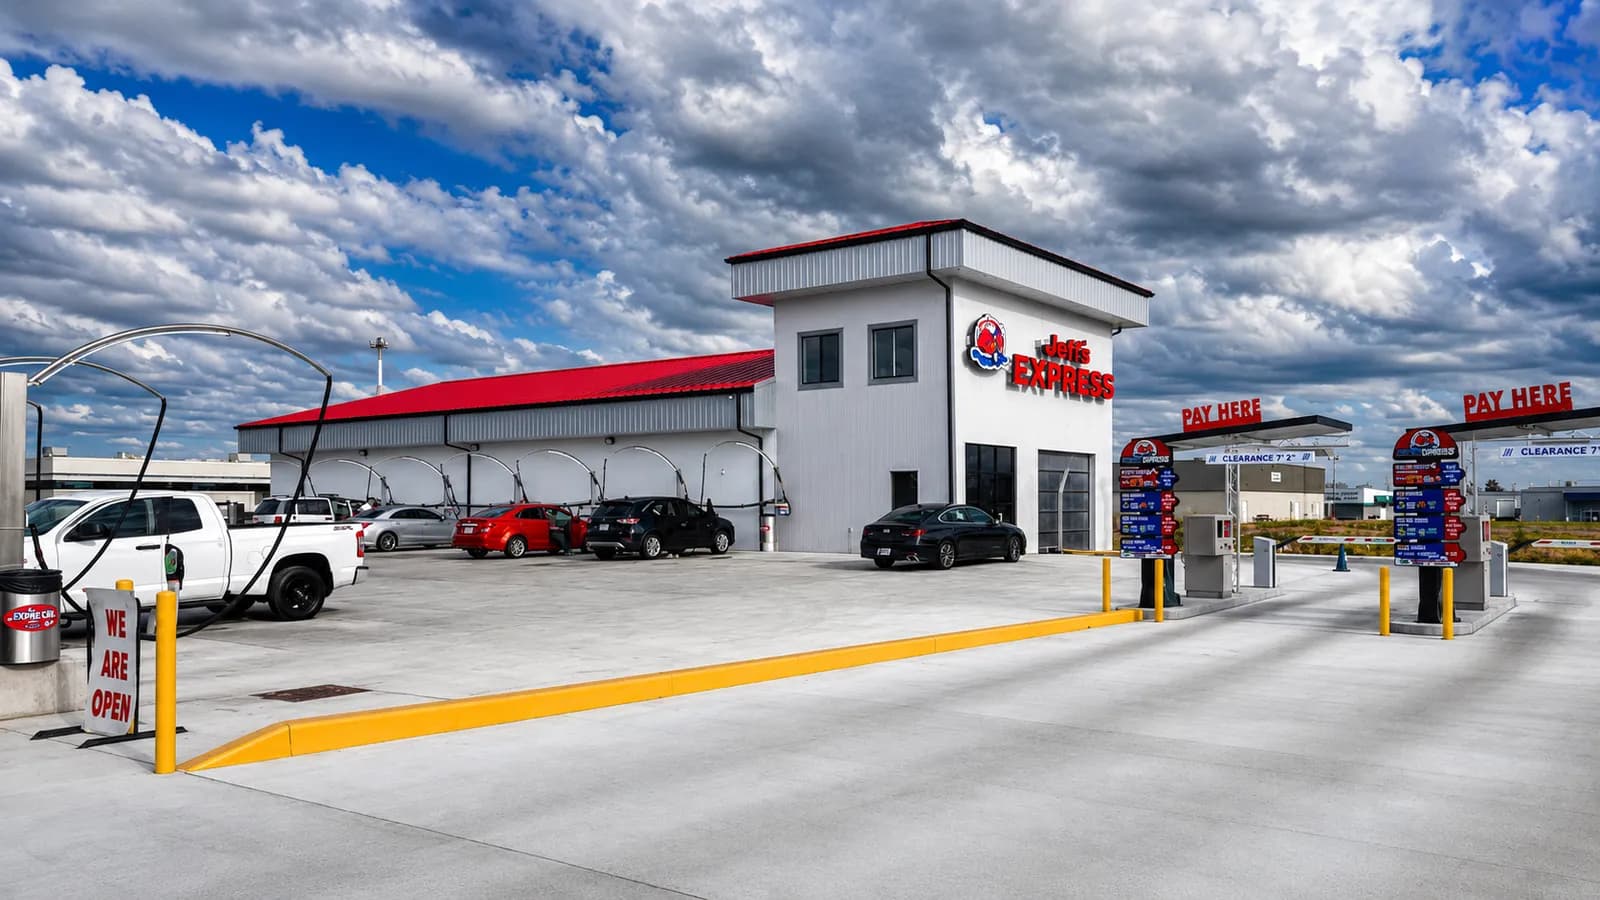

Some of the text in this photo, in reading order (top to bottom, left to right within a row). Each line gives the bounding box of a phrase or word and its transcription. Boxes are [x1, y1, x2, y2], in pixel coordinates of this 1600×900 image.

[1012, 353, 1115, 400] EXPRESS
[1182, 397, 1261, 426] PAY HERE
[1463, 381, 1571, 415] PAY HERE
[1222, 453, 1273, 463] CLEARANCE
[1520, 446, 1587, 456] CLEARANCE
[105, 608, 127, 639] WE
[100, 649, 129, 681] ARE
[91, 688, 132, 723] OPEN
